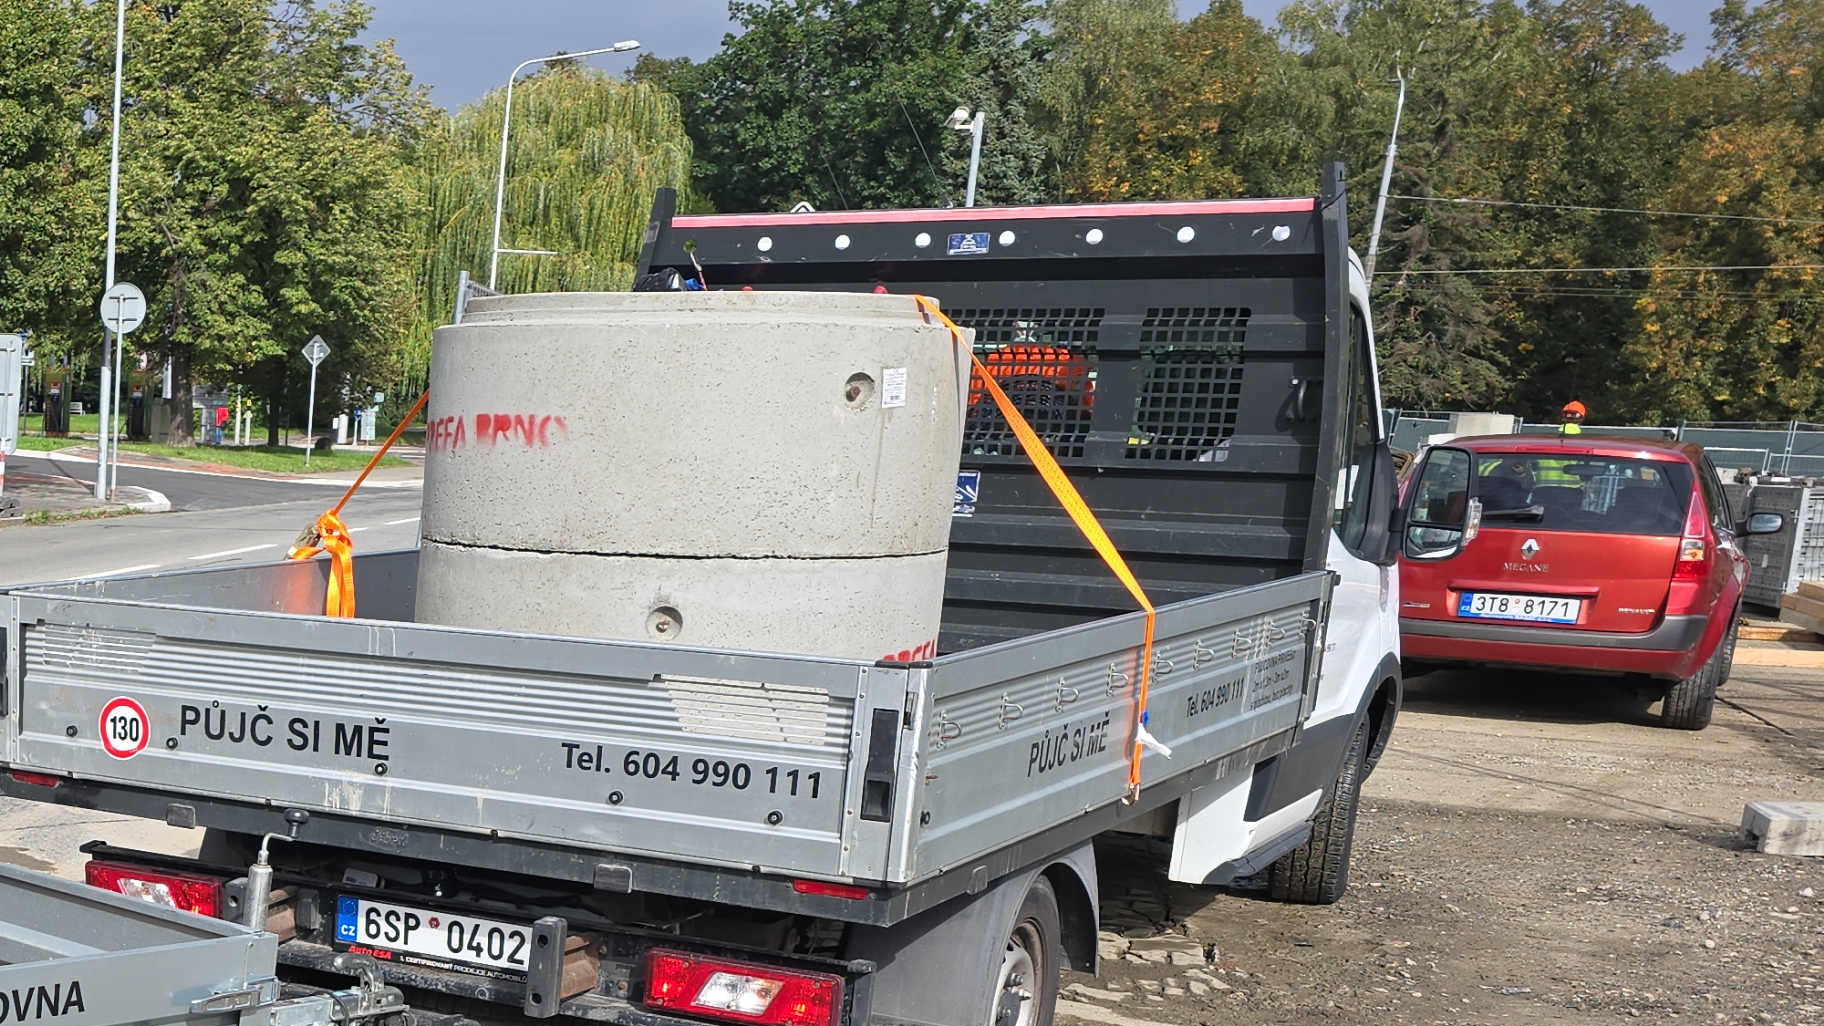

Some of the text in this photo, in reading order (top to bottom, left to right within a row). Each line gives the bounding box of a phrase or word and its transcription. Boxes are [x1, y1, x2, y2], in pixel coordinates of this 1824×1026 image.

[1475, 596, 1509, 613] 3T8
[1523, 599, 1570, 618] 8171
[1200, 688, 1216, 713] 604
[1215, 682, 1230, 708] 990
[1231, 676, 1244, 700] 111
[109, 715, 140, 742] 130
[179, 699, 391, 761] PŮJČ SI MĚ
[1027, 710, 1111, 778] PŮJČ SI MĚ
[561, 742, 822, 799] Tel. 604 990 111
[340, 906, 526, 966] CZ 6SP 0402
